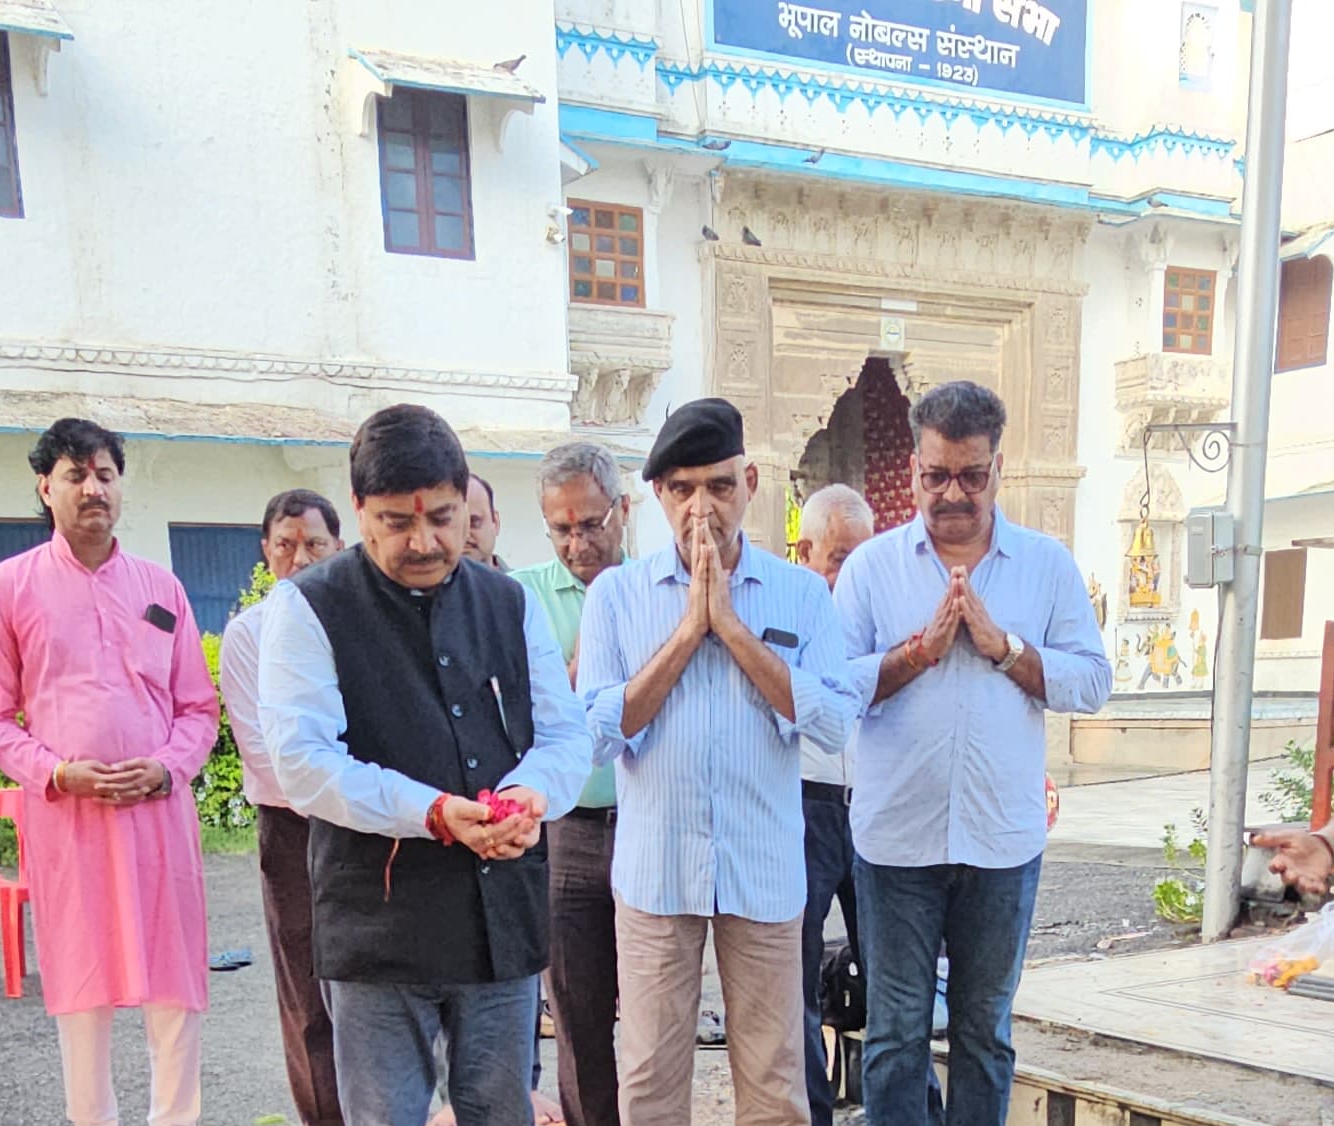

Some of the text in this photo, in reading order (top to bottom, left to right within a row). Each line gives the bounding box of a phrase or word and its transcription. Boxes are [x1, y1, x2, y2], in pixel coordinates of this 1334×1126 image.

[778, 1, 1020, 68] भूपाल नोबल्स संस्थान
[992, 0, 1061, 46] सभा
[846, 43, 913, 73] (स्थापना
